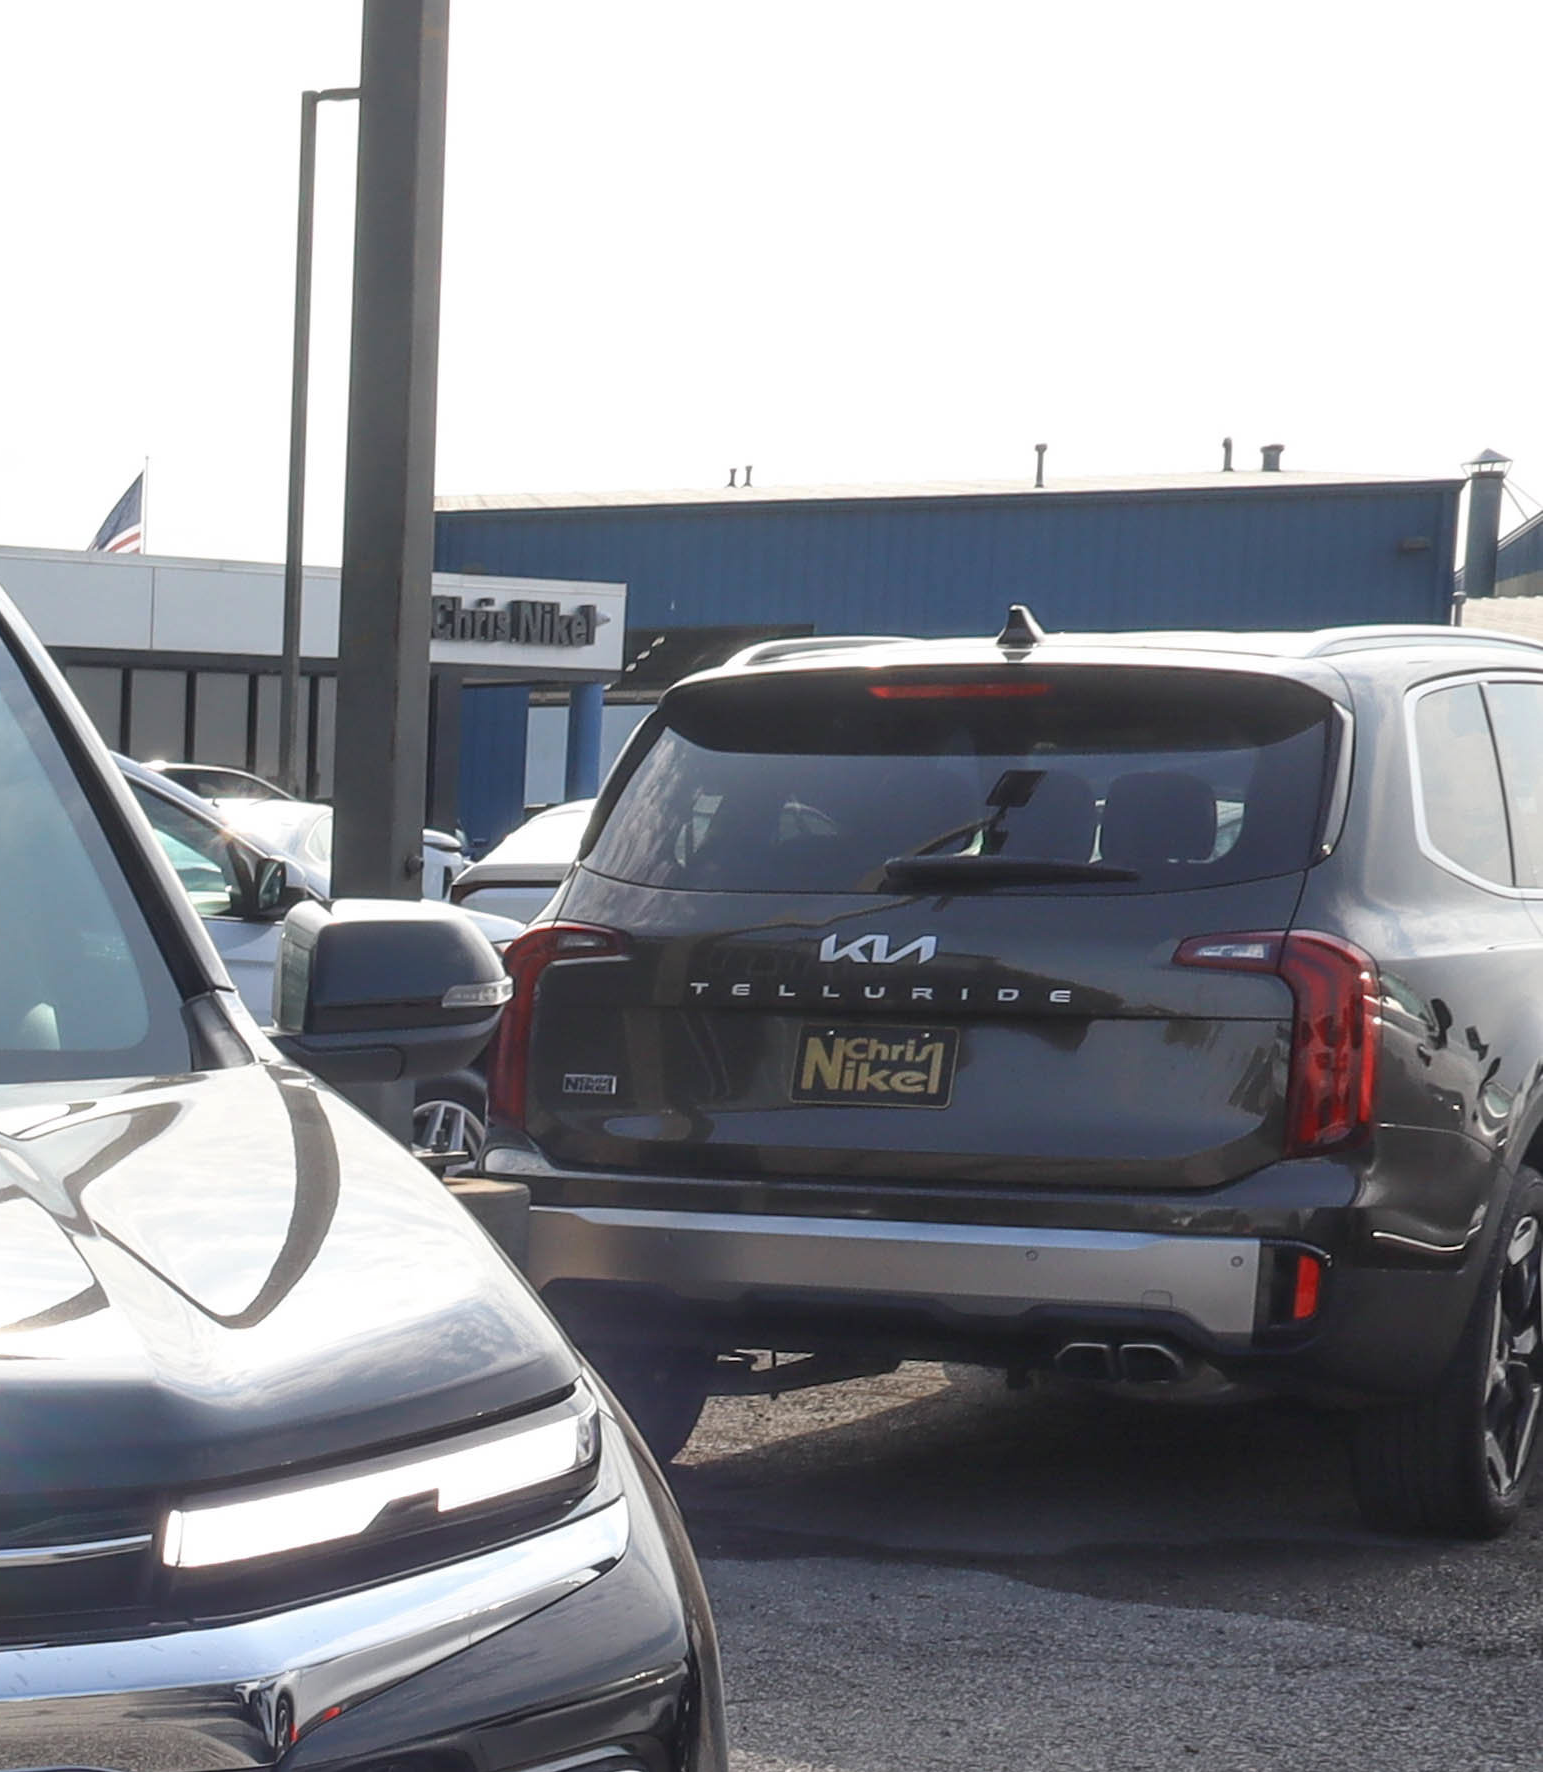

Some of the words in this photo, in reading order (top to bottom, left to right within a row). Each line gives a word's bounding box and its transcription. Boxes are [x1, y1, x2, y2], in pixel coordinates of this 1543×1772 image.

[432, 595, 507, 642] Chris
[508, 600, 596, 647] Nikel
[690, 982, 1072, 1003] TELLURIDE
[801, 1037, 945, 1095] Nikel
[844, 1036, 933, 1063] Chris
